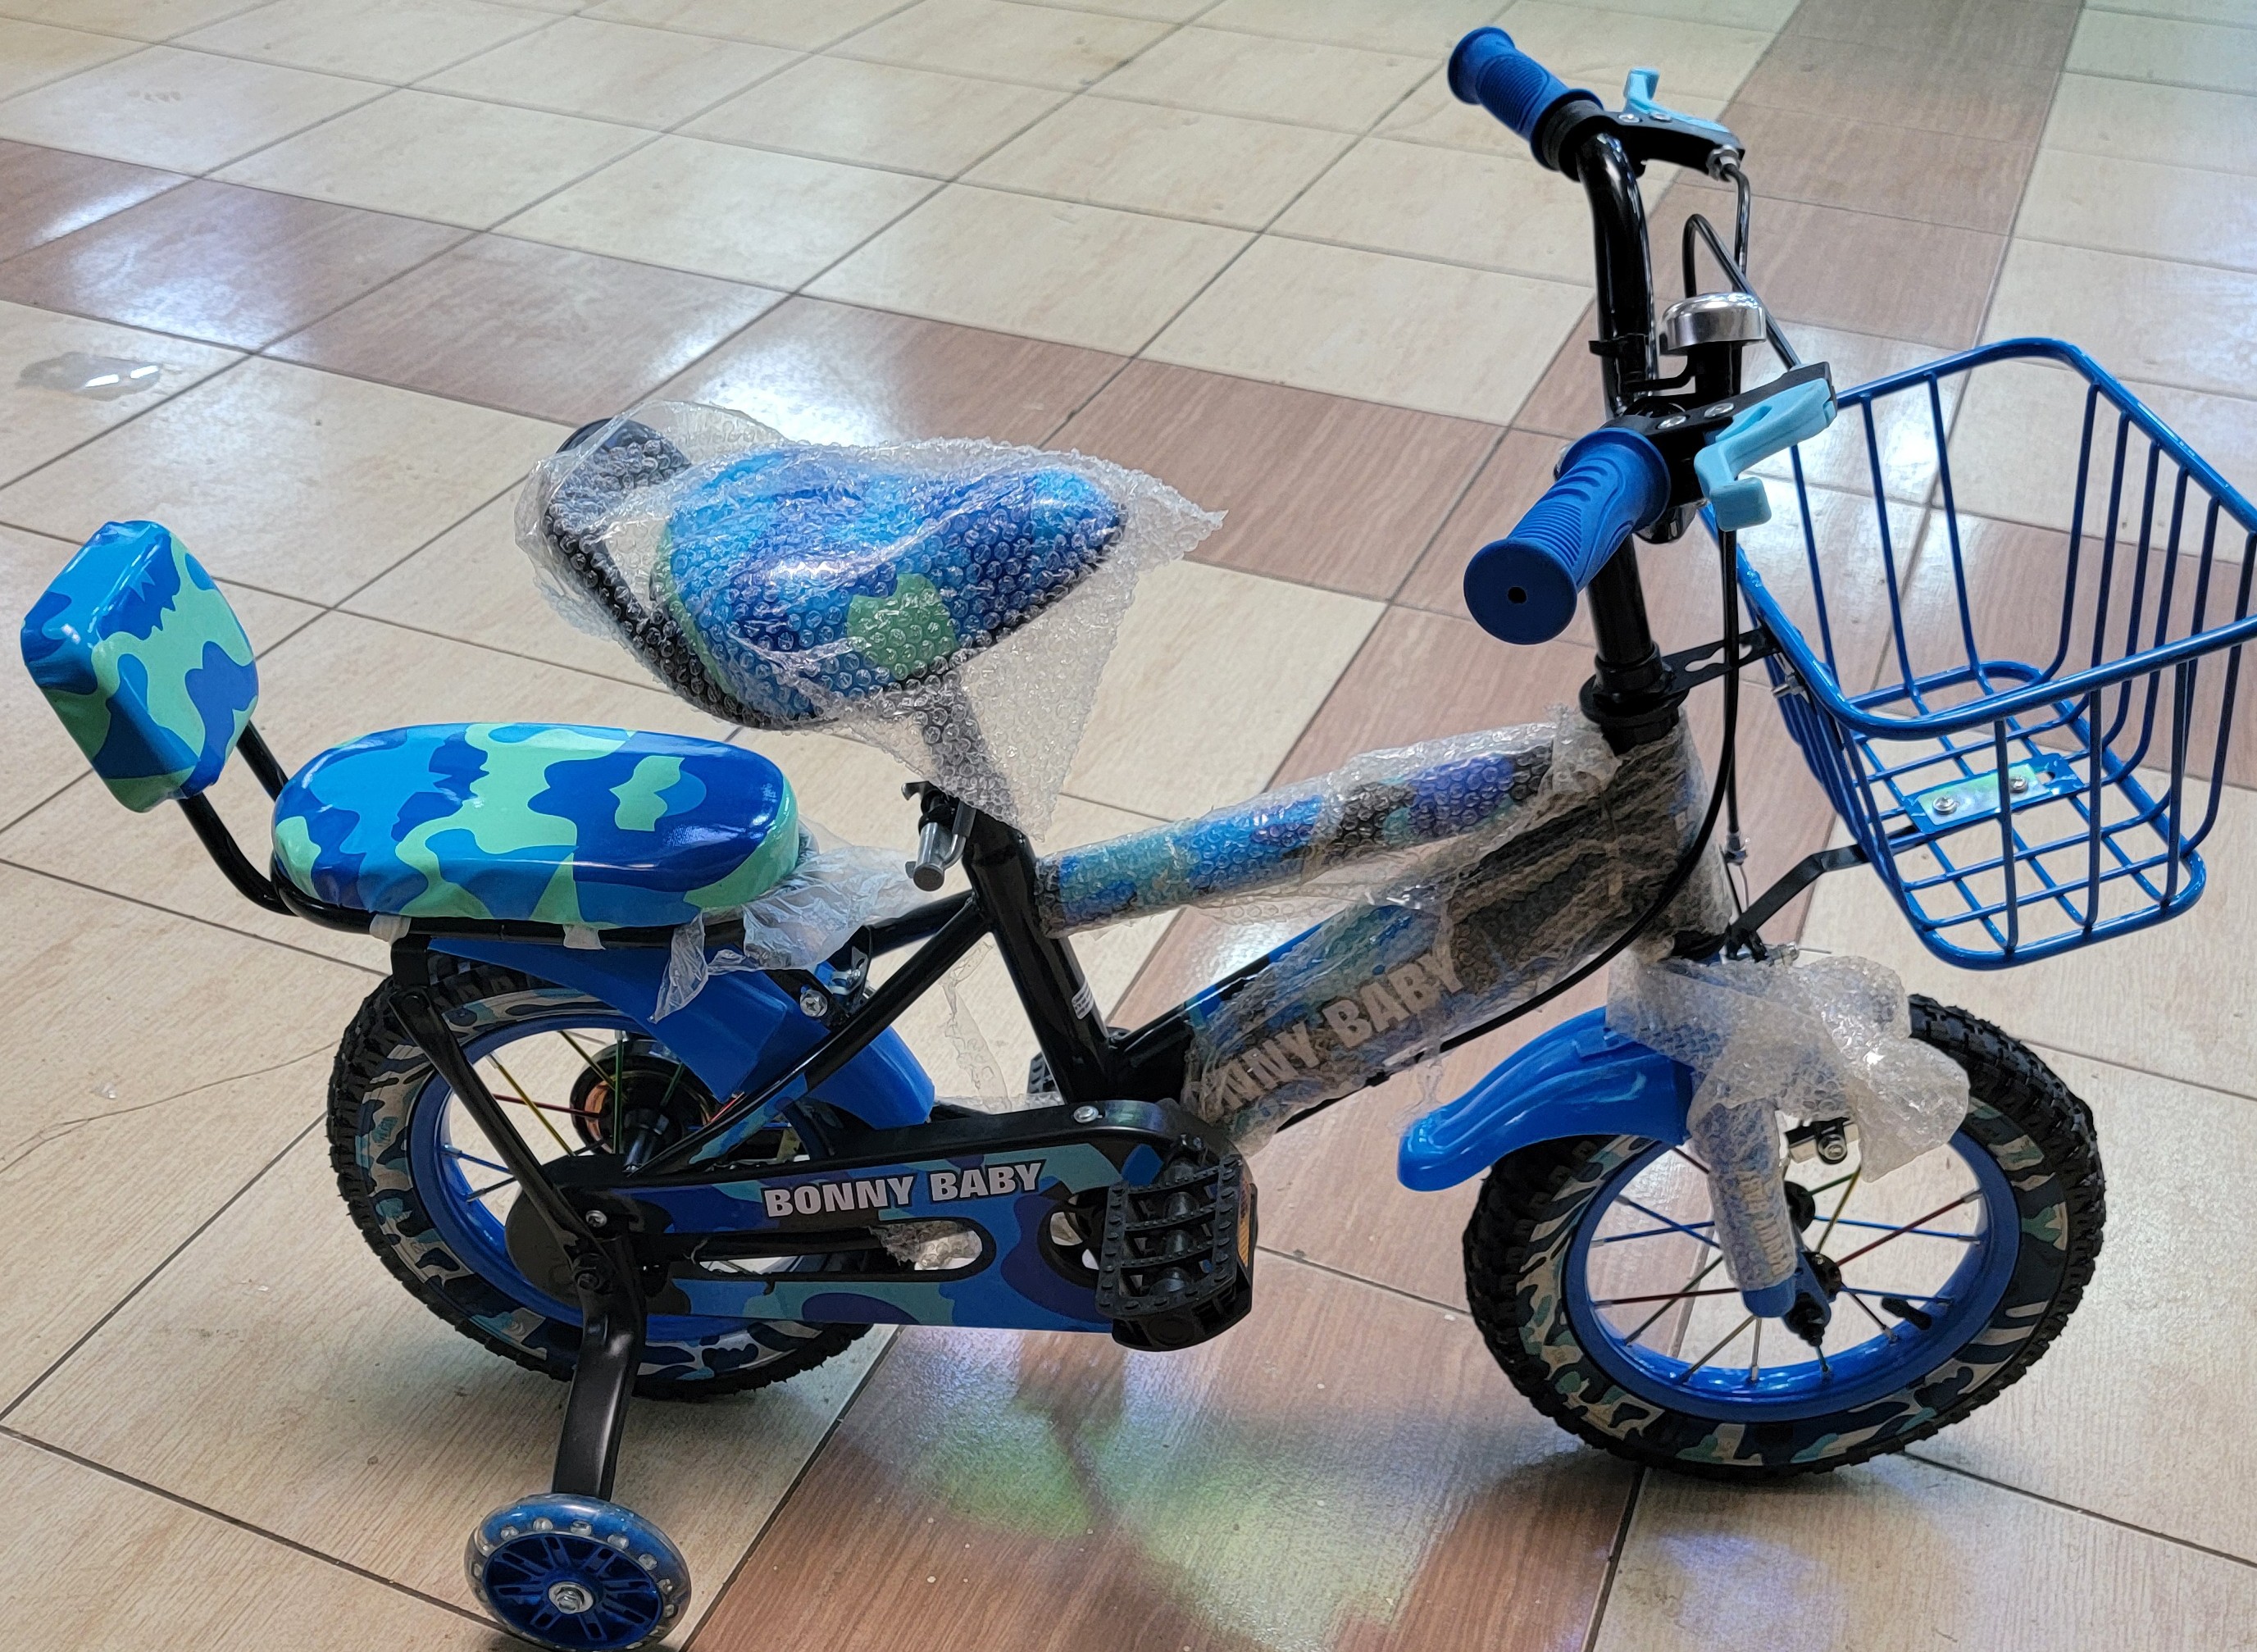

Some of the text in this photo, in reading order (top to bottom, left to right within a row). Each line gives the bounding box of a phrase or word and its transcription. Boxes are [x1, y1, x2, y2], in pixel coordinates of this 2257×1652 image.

[1322, 948, 1463, 1048] BABY
[764, 1163, 1042, 1217] BONNY BABY
